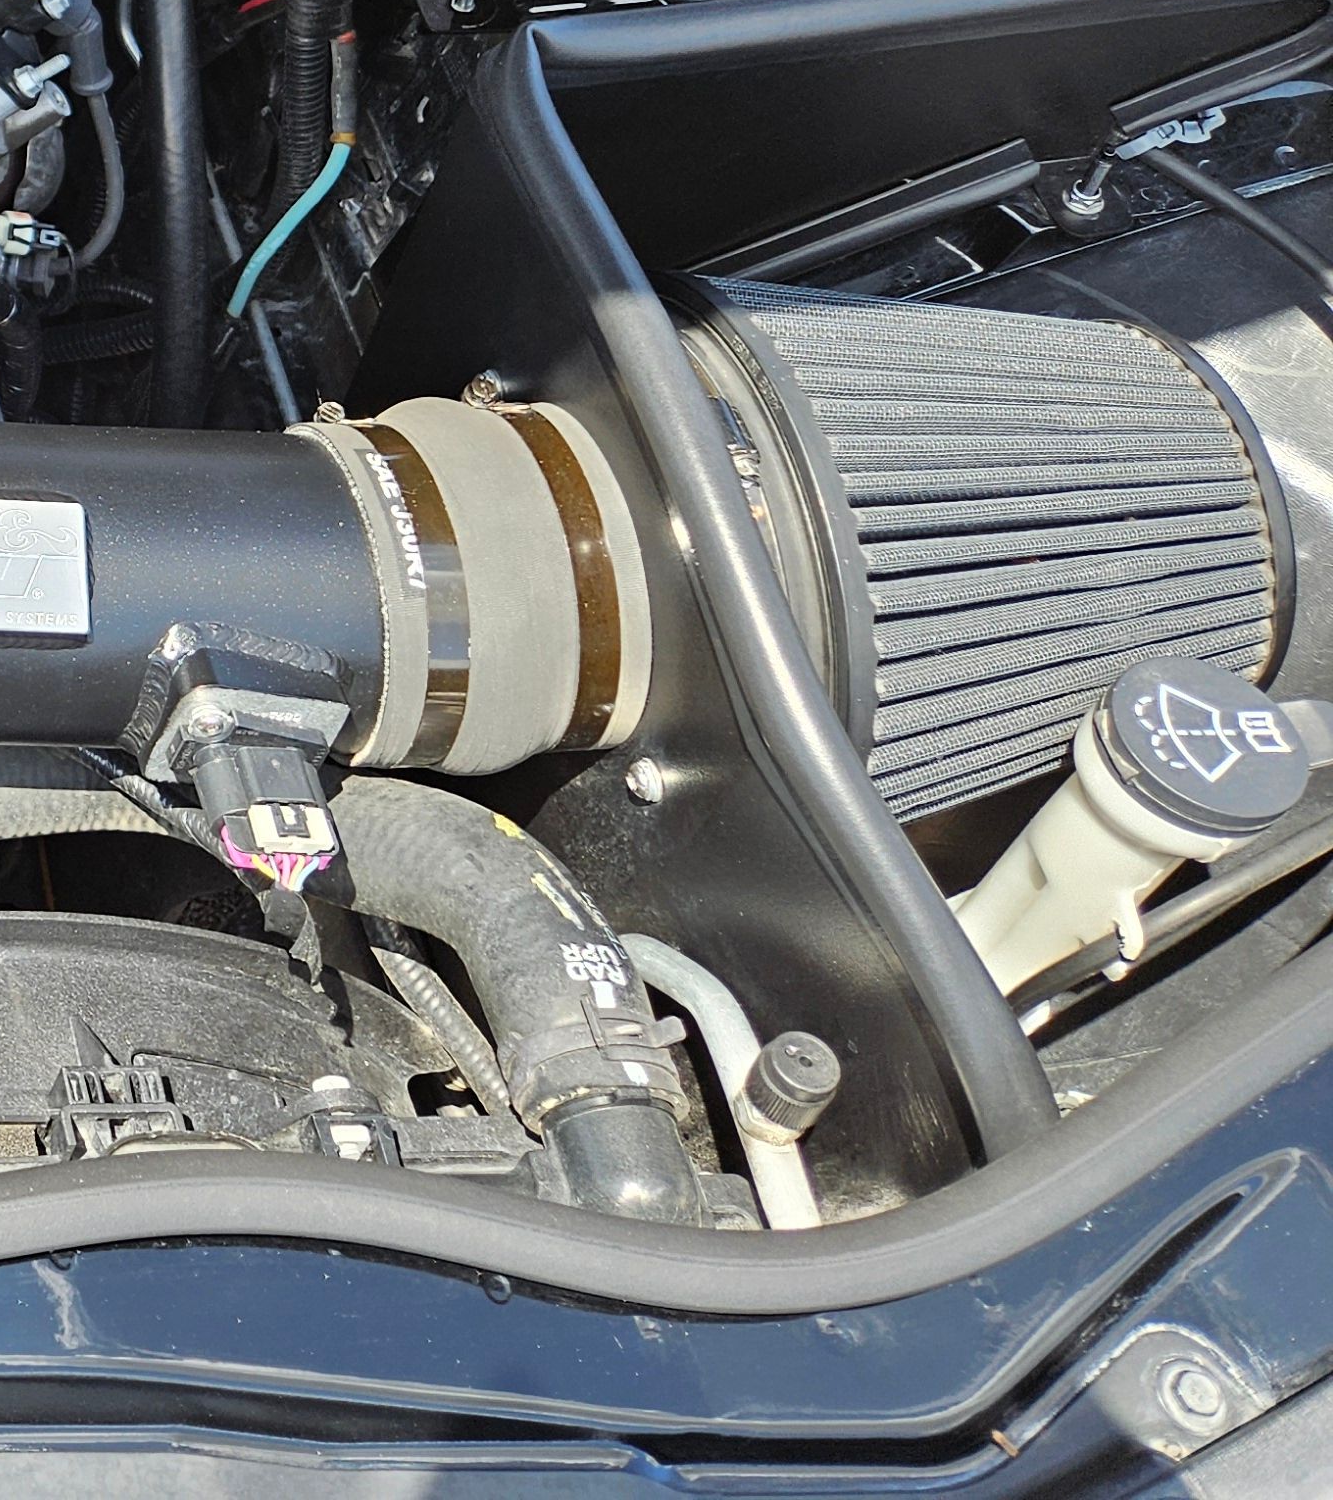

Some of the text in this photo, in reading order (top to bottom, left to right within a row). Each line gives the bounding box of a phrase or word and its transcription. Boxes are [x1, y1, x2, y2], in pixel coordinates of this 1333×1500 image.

[5, 612, 79, 628] SYSTEMS
[559, 943, 622, 966] UPR
[565, 961, 628, 986] RAD
